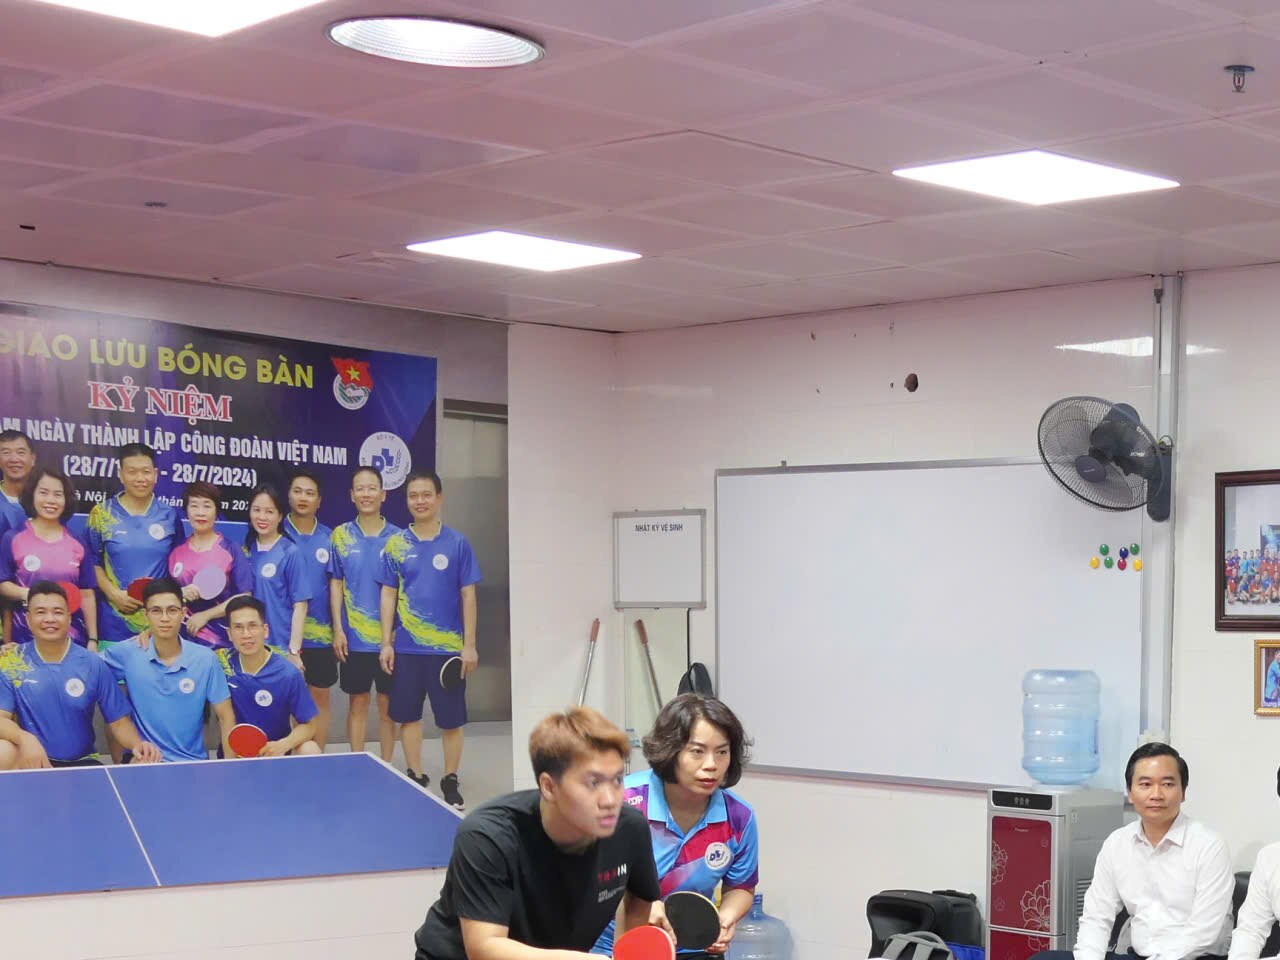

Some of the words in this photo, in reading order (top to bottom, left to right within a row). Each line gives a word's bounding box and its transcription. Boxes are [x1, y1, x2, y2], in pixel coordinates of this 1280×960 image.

[90, 338, 147, 369] LƯU
[157, 343, 247, 381] BÓNG
[256, 354, 313, 389] BÀN
[88, 376, 139, 412] KỶ
[145, 384, 233, 426] NIỆM
[26, 417, 76, 443] NGÀY
[80, 422, 140, 448] THÀNH
[144, 427, 176, 454] LẬP
[181, 430, 226, 457] CÔNG
[230, 435, 274, 460] ĐOÀN
[277, 439, 309, 466] VIỆT
[312, 444, 348, 466] NAM
[172, 463, 257, 489] 28/7/2024)
